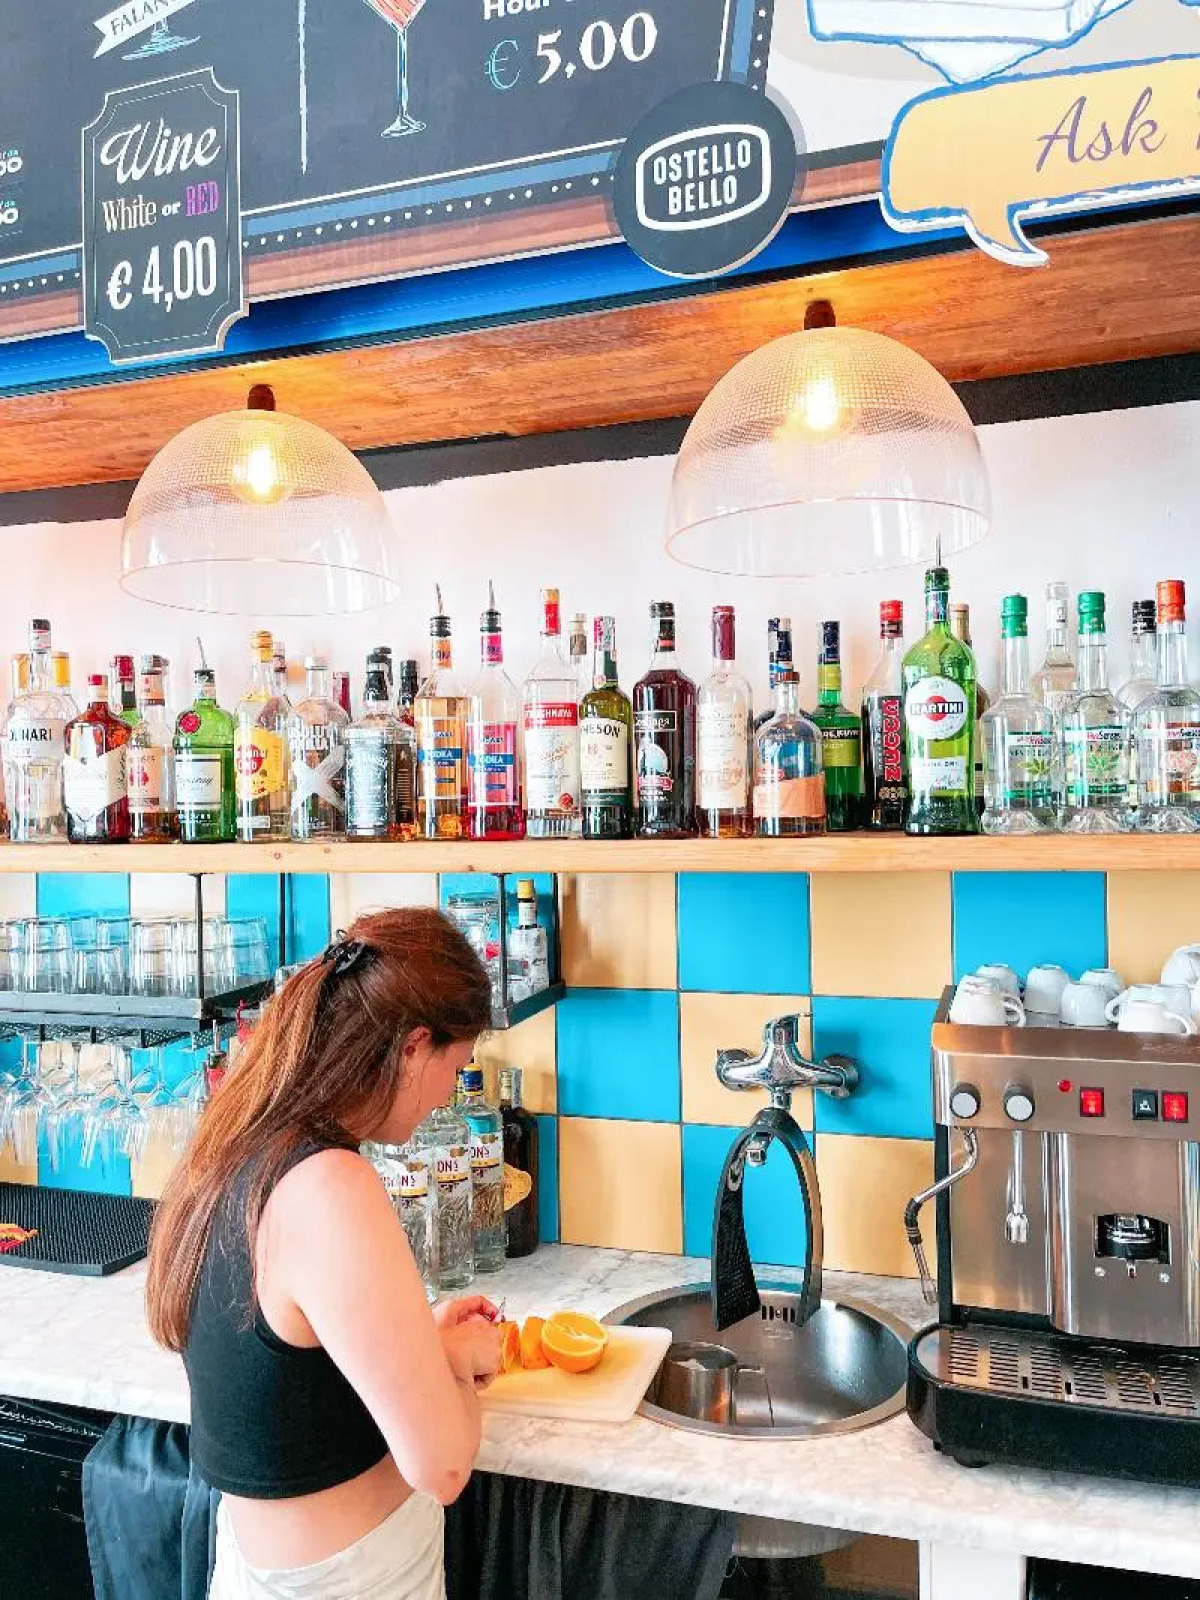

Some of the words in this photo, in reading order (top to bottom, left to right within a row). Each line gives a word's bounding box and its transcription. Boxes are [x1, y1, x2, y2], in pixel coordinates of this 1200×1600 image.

[483, 39, 522, 91] €
[536, 11, 658, 84] 5,00
[100, 117, 221, 184] Wine
[1035, 86, 1167, 172] Ask
[653, 138, 752, 183] OSTELLO
[102, 194, 157, 233] White
[161, 201, 182, 217] or
[185, 180, 219, 217] RED
[667, 174, 739, 217] BELLO
[106, 260, 132, 310] €
[142, 236, 217, 312] 4,00
[910, 702, 963, 715] MARTINI
[427, 748, 454, 759] ODKA
[882, 697, 901, 782] ZUCCA
